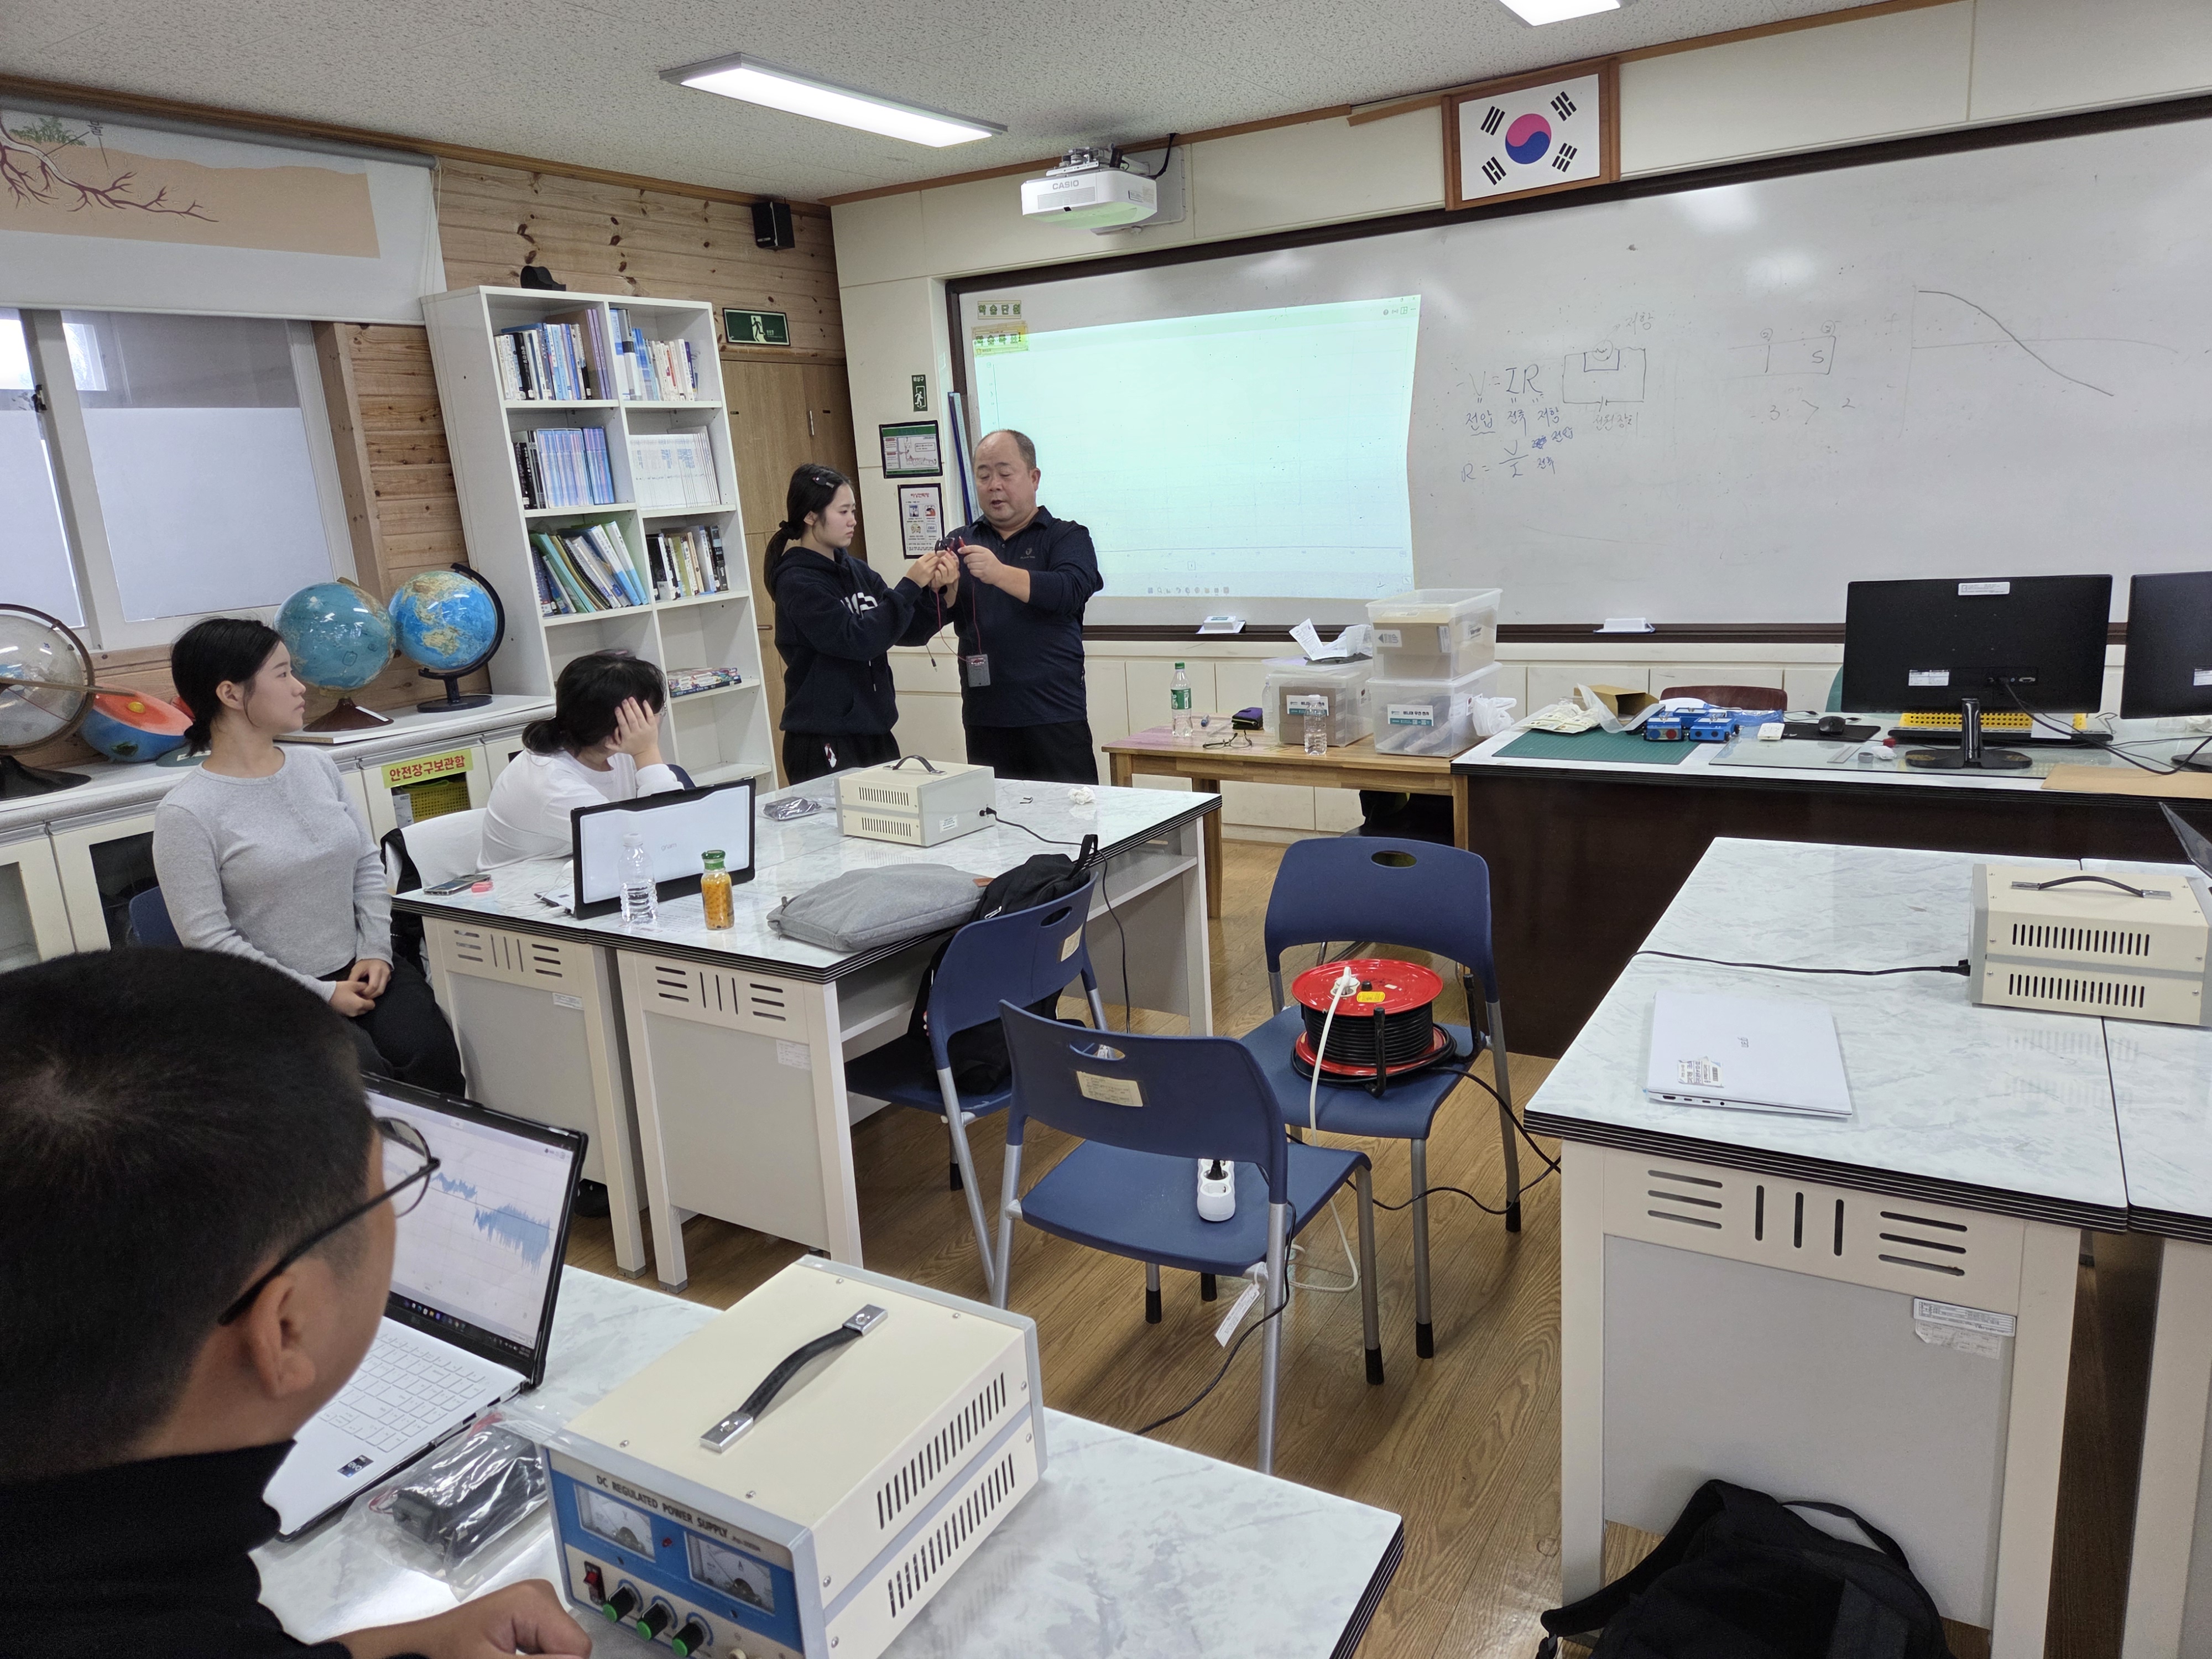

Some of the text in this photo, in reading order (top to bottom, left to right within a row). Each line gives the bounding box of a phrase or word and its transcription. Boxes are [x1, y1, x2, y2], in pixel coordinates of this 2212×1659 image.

[1052, 180, 1079, 190] CASIO
[1465, 410, 1493, 430] 전압
[1537, 406, 1559, 427] 저항
[389, 755, 465, 782] 안전장구보관함
[348, 1461, 362, 1471] evo
[597, 1475, 728, 1538] DC REGULATED POWER SUPPLY
